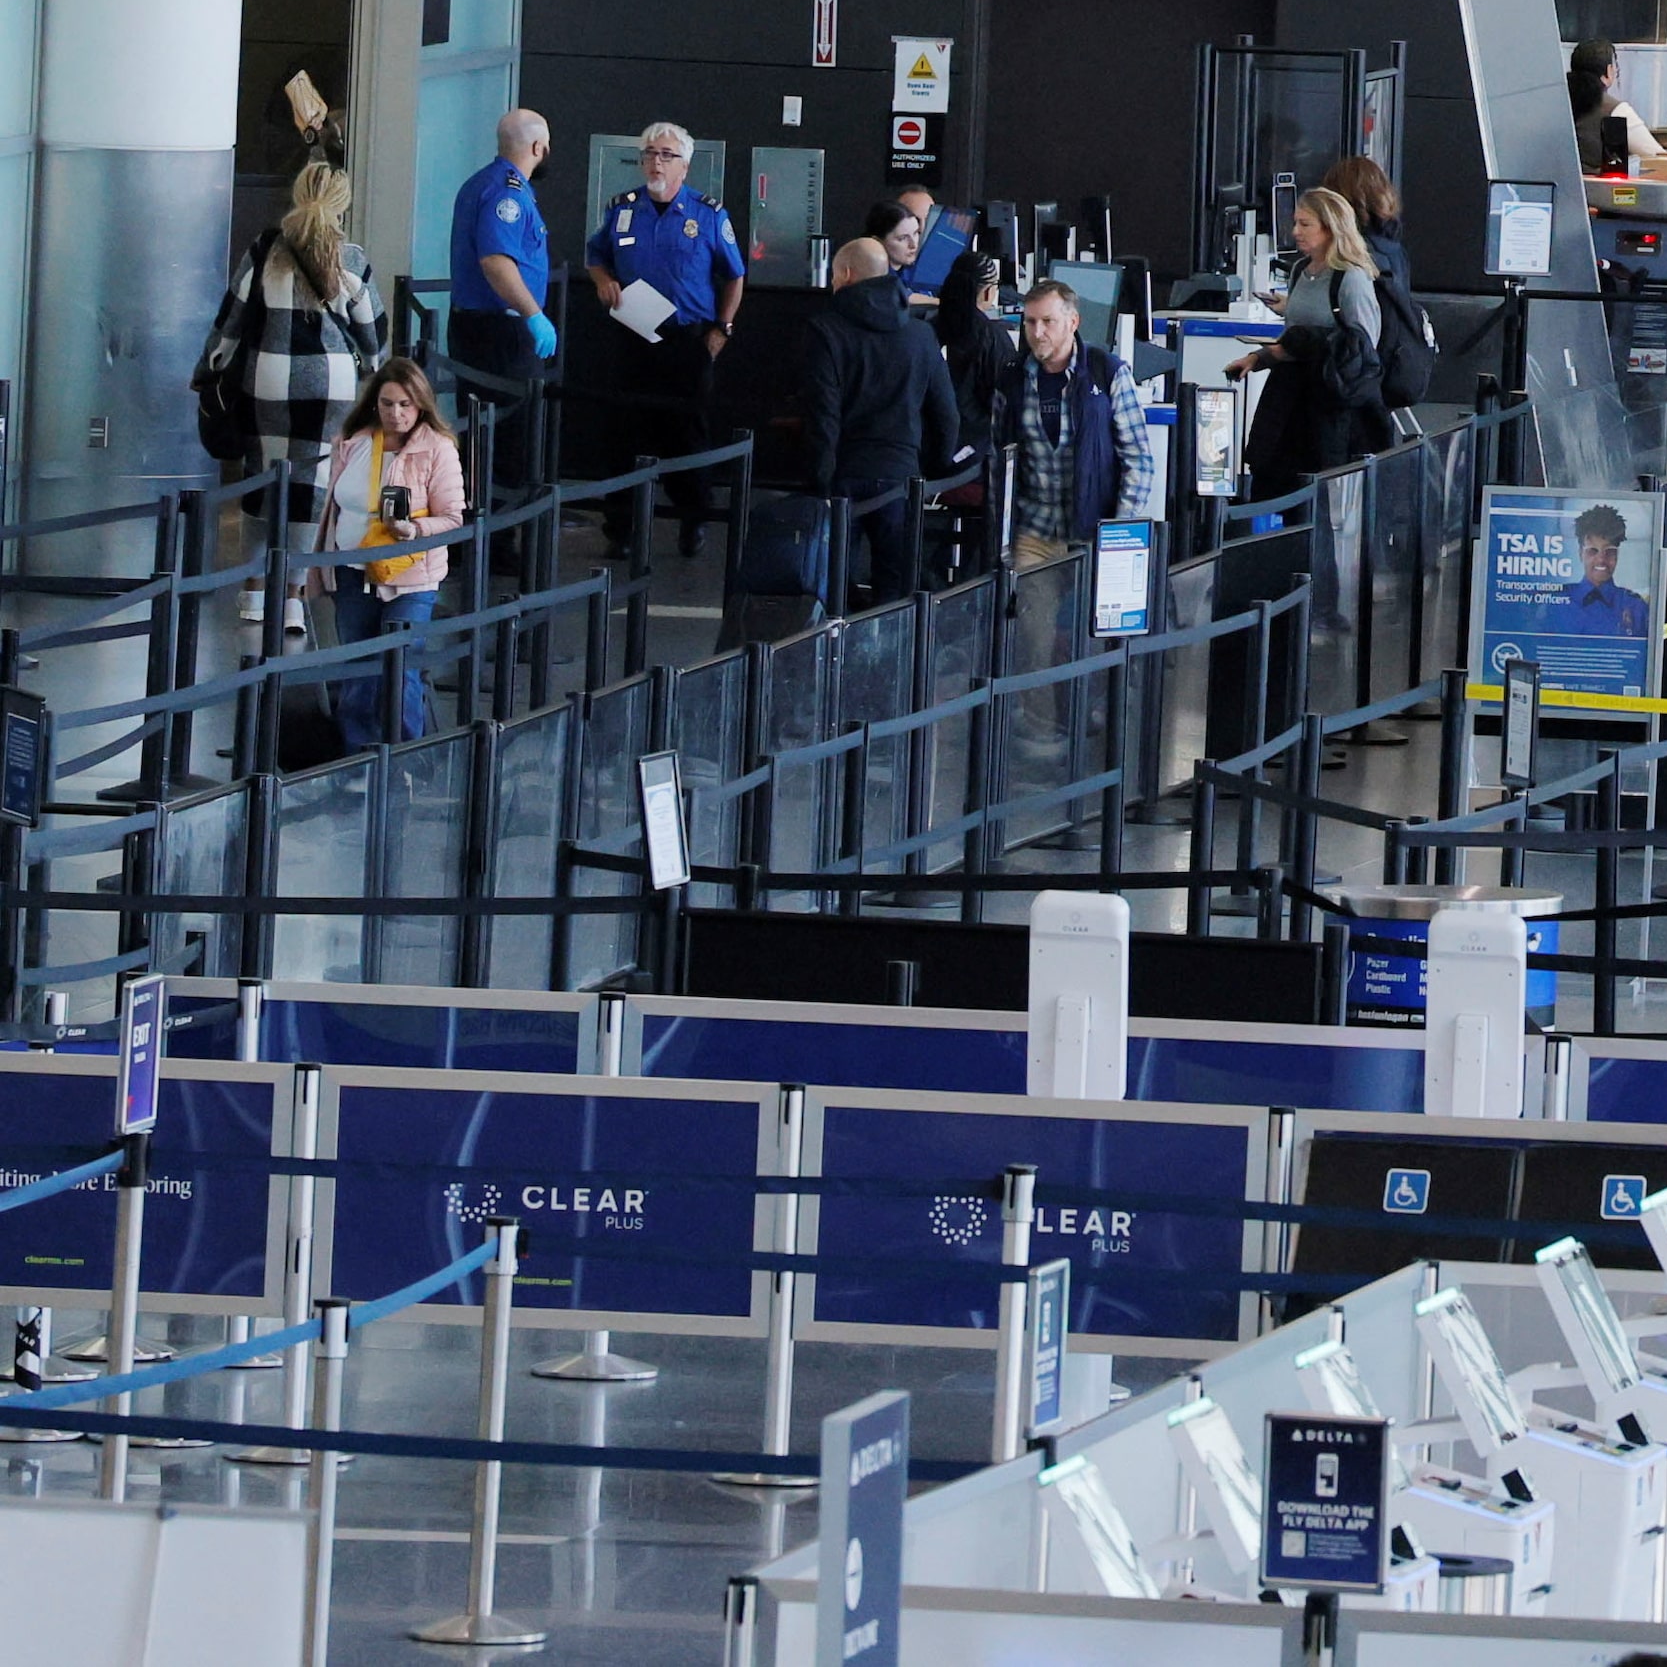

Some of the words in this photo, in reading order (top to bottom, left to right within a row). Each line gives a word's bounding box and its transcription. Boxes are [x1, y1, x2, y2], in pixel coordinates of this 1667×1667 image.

[1497, 533, 1539, 553] TSA
[1544, 535, 1564, 554] IS
[1496, 555, 1572, 577] HIRING
[1496, 579, 1563, 591] Transportation
[1495, 592, 1532, 604] Security
[1534, 593, 1570, 605] Officers
[133, 1023, 151, 1047] EXIT
[522, 1186, 645, 1214] CLEAR
[605, 1216, 643, 1230] PLUS
[1092, 1238, 1130, 1253] PLUS
[1306, 1430, 1354, 1444] DELTA
[1277, 1501, 1350, 1516] DOWNLOAD
[1352, 1505, 1375, 1519] THE
[1282, 1514, 1304, 1528] FLY
[1305, 1515, 1344, 1530] DELTA
[1345, 1517, 1369, 1531] APP
